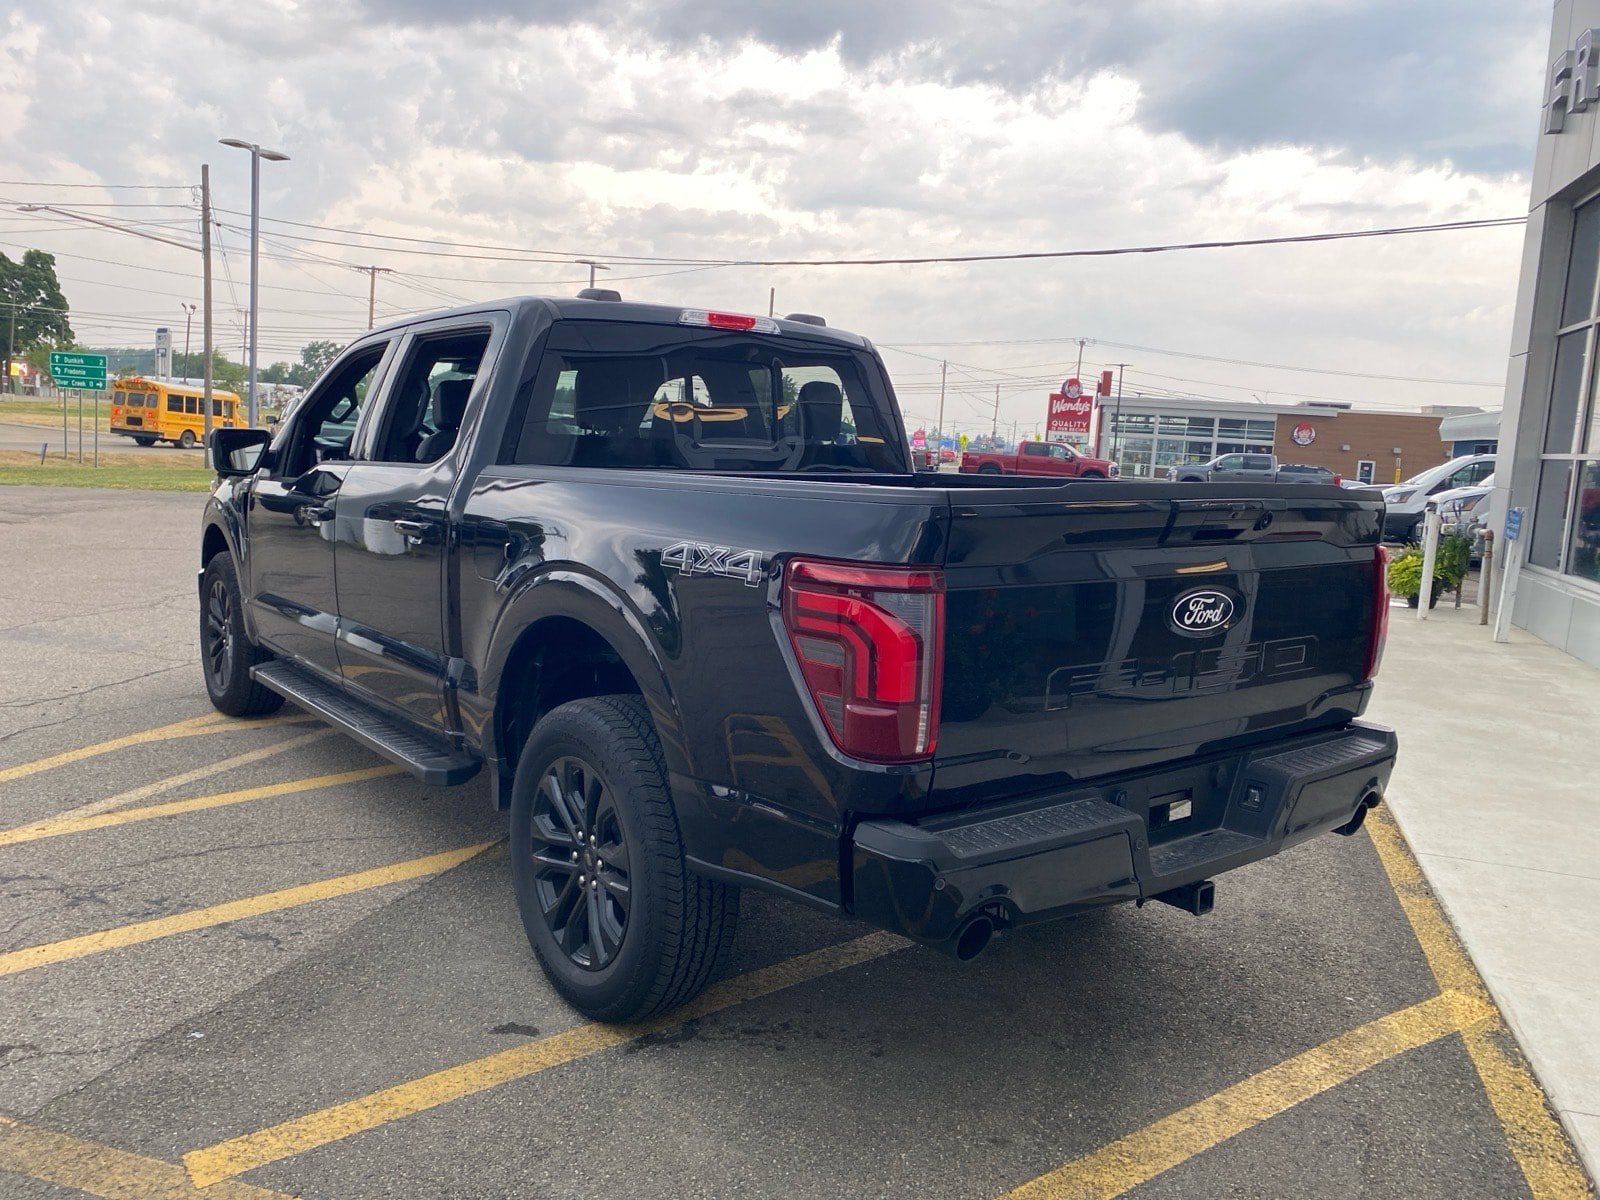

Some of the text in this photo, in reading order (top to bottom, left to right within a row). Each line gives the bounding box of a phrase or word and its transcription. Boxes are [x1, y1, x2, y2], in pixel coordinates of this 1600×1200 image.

[1544, 29, 1600, 135] FR
[64, 356, 84, 364] Dunkirk
[64, 367, 86, 375] Fredonia
[71, 379, 86, 387] Creek
[1052, 398, 1091, 415] Wendy's
[1051, 420, 1088, 428] QUALITY
[1184, 597, 1224, 625] Ford
[1044, 634, 1320, 711] F-150
